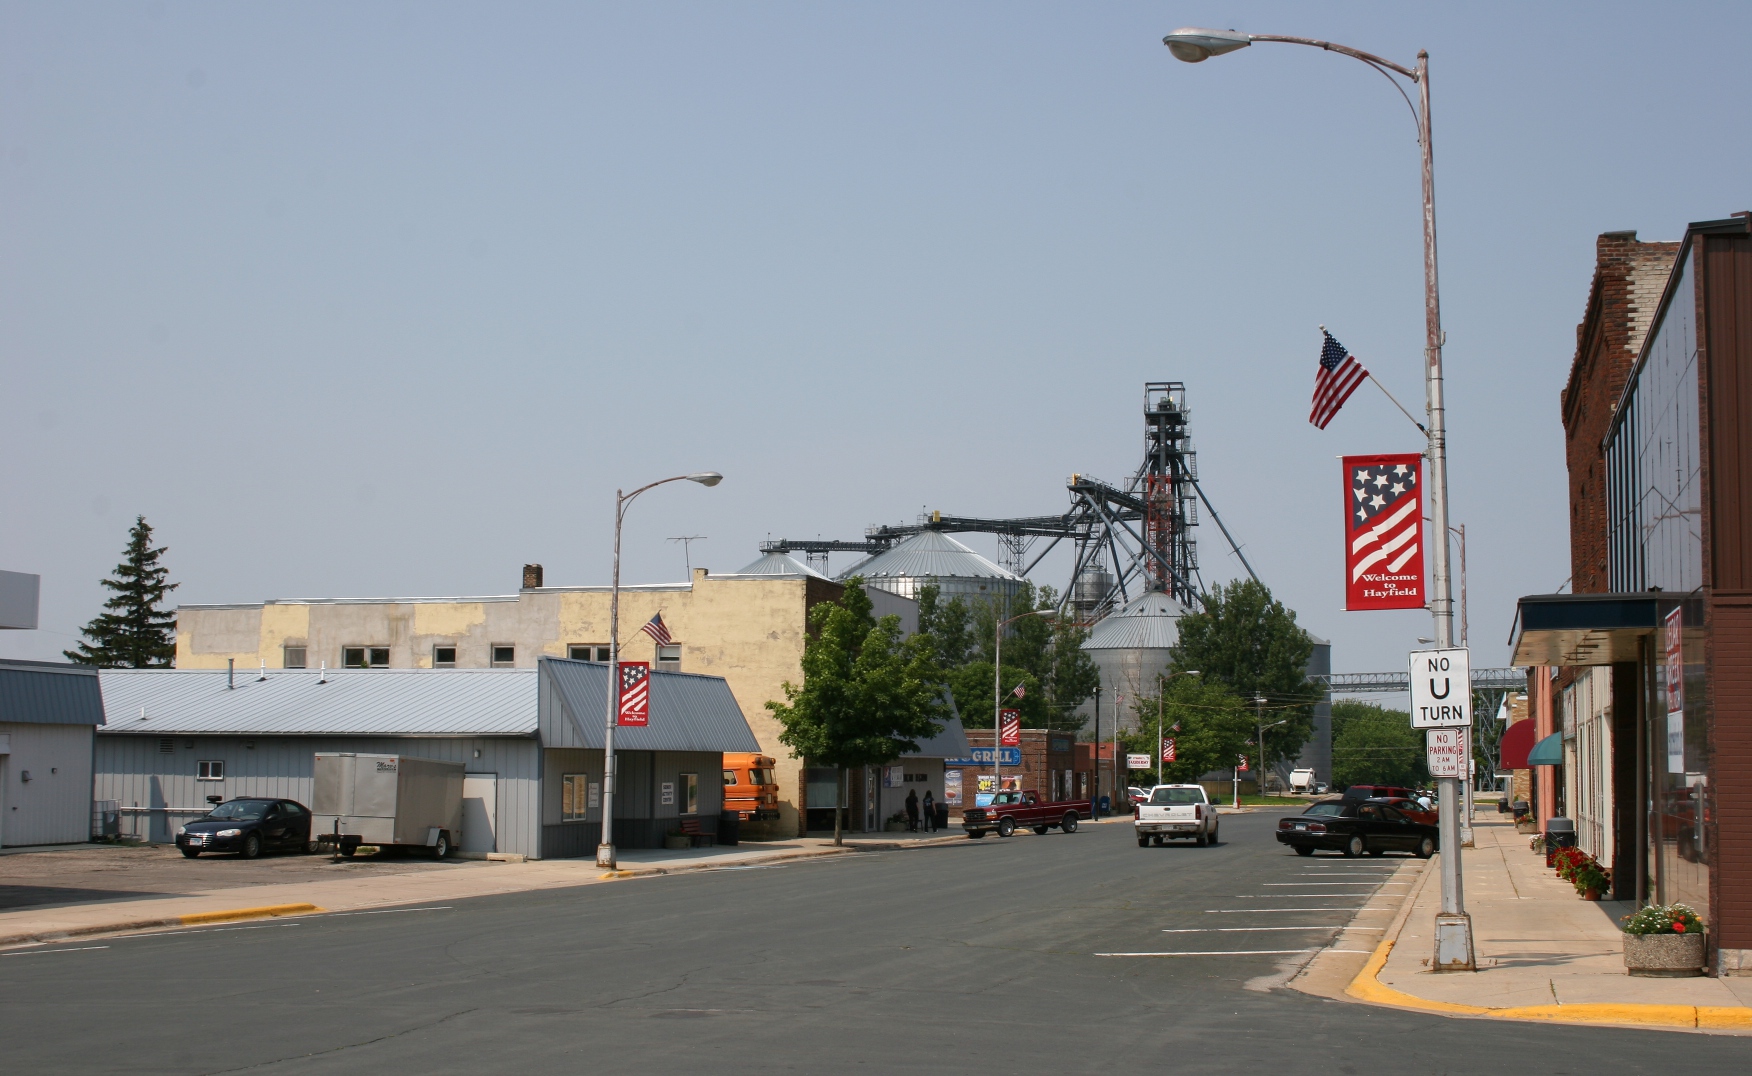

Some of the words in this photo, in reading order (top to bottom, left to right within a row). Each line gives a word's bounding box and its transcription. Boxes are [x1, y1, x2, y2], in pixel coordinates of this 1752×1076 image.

[1361, 574, 1418, 582] Welcome
[1363, 588, 1418, 598] Hayfield
[1428, 657, 1450, 672] NO
[1429, 677, 1450, 700] U
[1420, 705, 1463, 721] TURN
[1436, 735, 1448, 744] NO
[1429, 746, 1457, 755] PARKING
[972, 751, 1012, 762] GRILL
